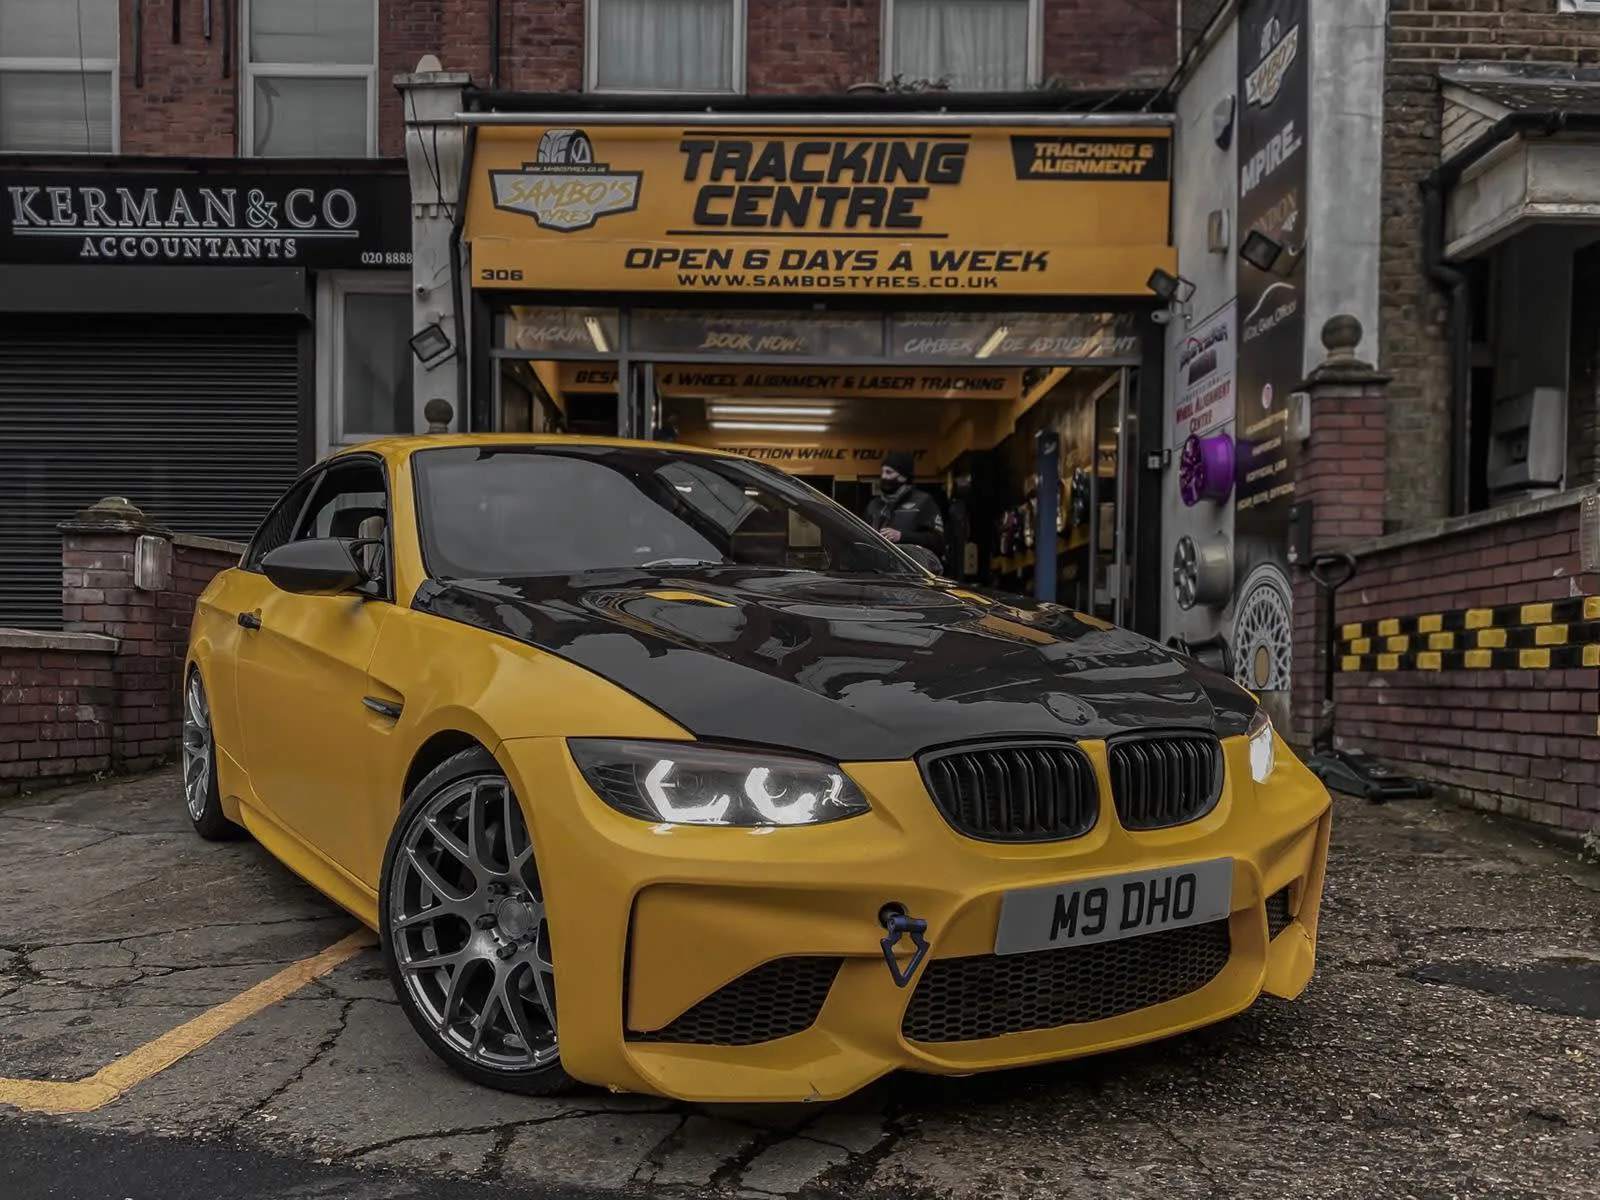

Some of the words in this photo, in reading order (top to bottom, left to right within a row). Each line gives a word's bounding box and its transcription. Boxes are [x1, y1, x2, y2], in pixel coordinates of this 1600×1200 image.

[1034, 142, 1136, 158] TRACKING
[1138, 145, 1154, 159] &
[1241, 119, 1295, 198] MPIRE
[680, 140, 970, 184] TRACKING
[1029, 159, 1147, 175] ALIGNMENT
[502, 178, 634, 207] SAMBO'S
[540, 208, 592, 223] TYRES
[693, 184, 930, 228] CENTRE
[80, 237, 298, 259] ACCOUNTANTS
[361, 251, 383, 264] 020
[385, 251, 413, 264] 8888
[624, 247, 734, 270] OPEN
[742, 249, 771, 271] 6
[779, 249, 878, 272] DAYS
[888, 250, 913, 272] A
[930, 250, 1050, 273] WEEK
[481, 269, 523, 282] 306
[677, 273, 998, 289] WWW.SAMBOSTYRES.CO.UK
[517, 324, 591, 343] TRACKIN
[698, 331, 755, 351] BOOK
[755, 334, 806, 352] NOW!
[904, 336, 974, 353] CAMBER
[1030, 335, 1138, 353] ADJUSTENT
[662, 372, 673, 385] 4
[679, 373, 737, 387] WHEEL
[743, 374, 840, 389] ALIGNMENT
[842, 376, 855, 389] &
[858, 376, 916, 389] LASER
[920, 377, 1006, 391] TRACKING
[798, 448, 849, 461] WHILE
[853, 448, 884, 461] YOU
[1049, 887, 1109, 941] M9
[1119, 873, 1197, 930] DHO
